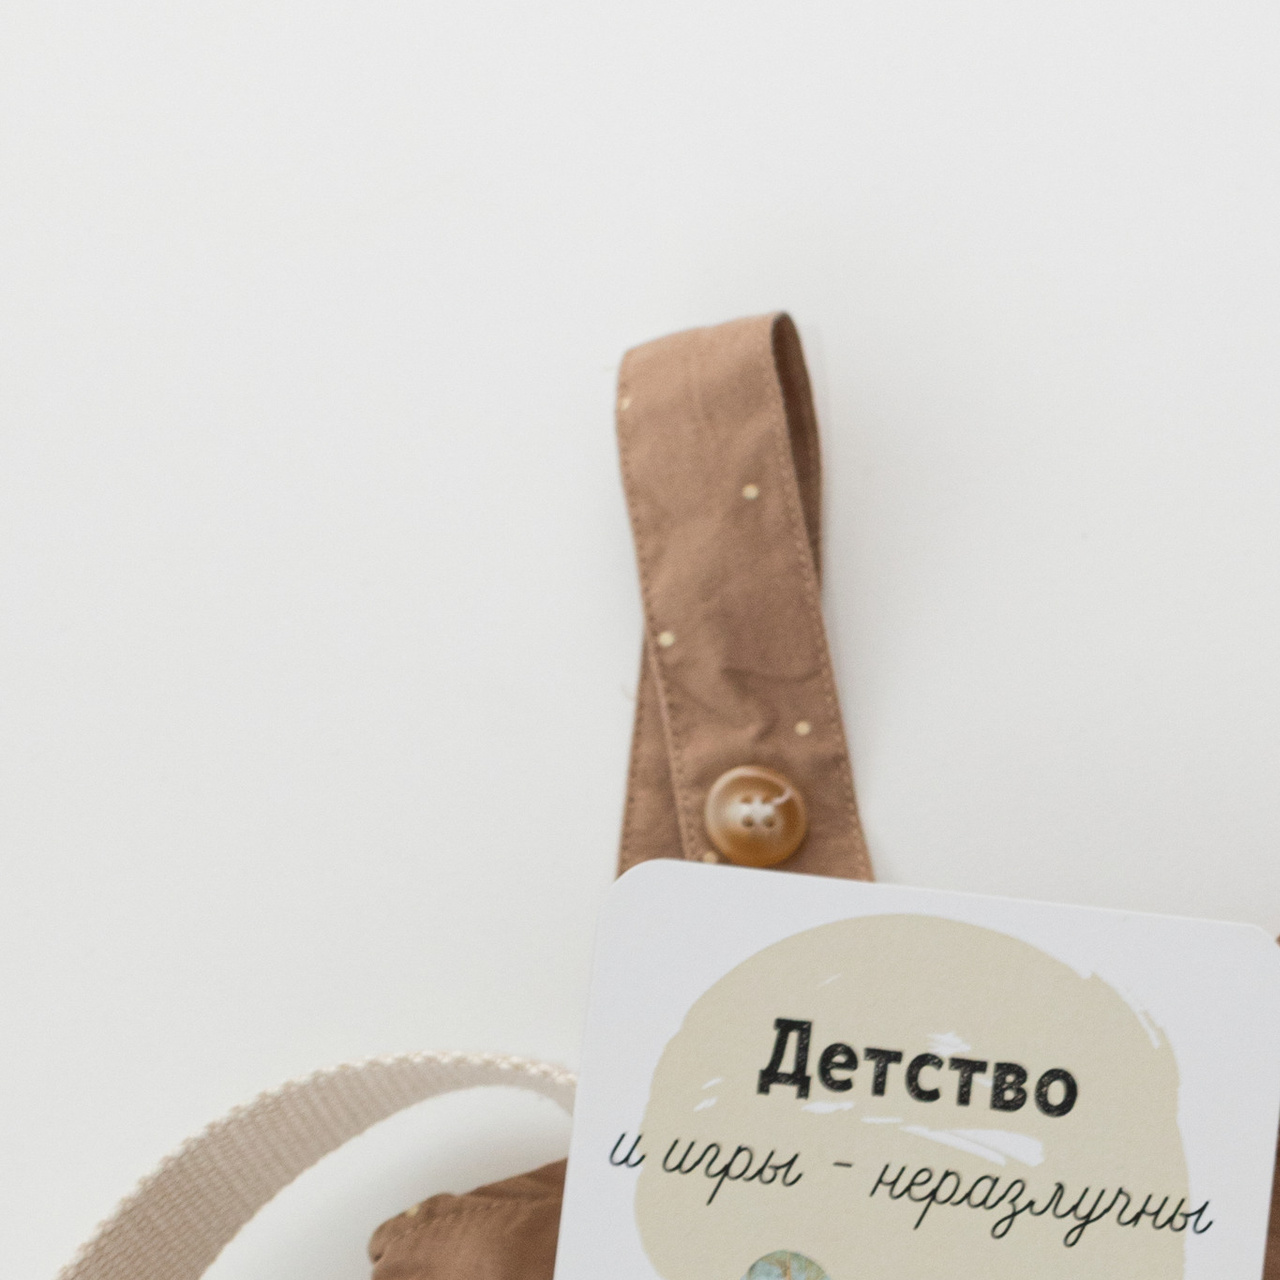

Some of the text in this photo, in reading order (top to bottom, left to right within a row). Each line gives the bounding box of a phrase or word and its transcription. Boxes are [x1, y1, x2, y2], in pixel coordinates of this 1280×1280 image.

[757, 1017, 1080, 1119] Детство
[609, 1131, 648, 1169] и
[661, 1136, 803, 1206] игры
[870, 1161, 1214, 1248] неразлучны
